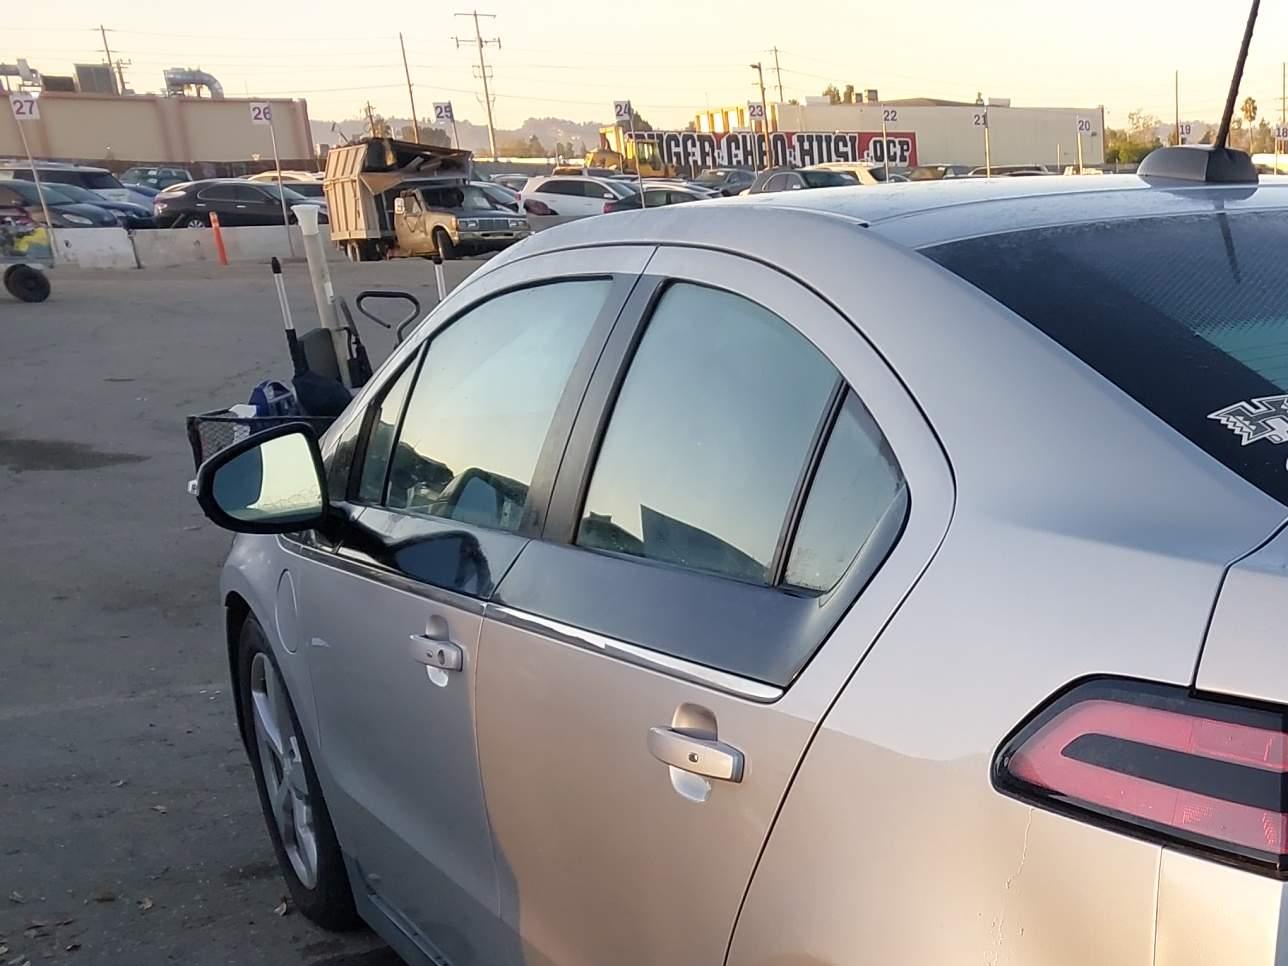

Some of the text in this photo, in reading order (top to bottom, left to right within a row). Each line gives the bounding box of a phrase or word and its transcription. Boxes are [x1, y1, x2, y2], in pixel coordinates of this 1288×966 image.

[12, 99, 36, 115] 27
[434, 105, 452, 119] 25
[615, 103, 630, 117] 24
[748, 105, 763, 117] 23
[251, 106, 272, 121] 26
[883, 110, 897, 122] 22
[974, 114, 987, 126] 21
[1078, 119, 1091, 131] 20
[1276, 126, 1288, 138] 18
